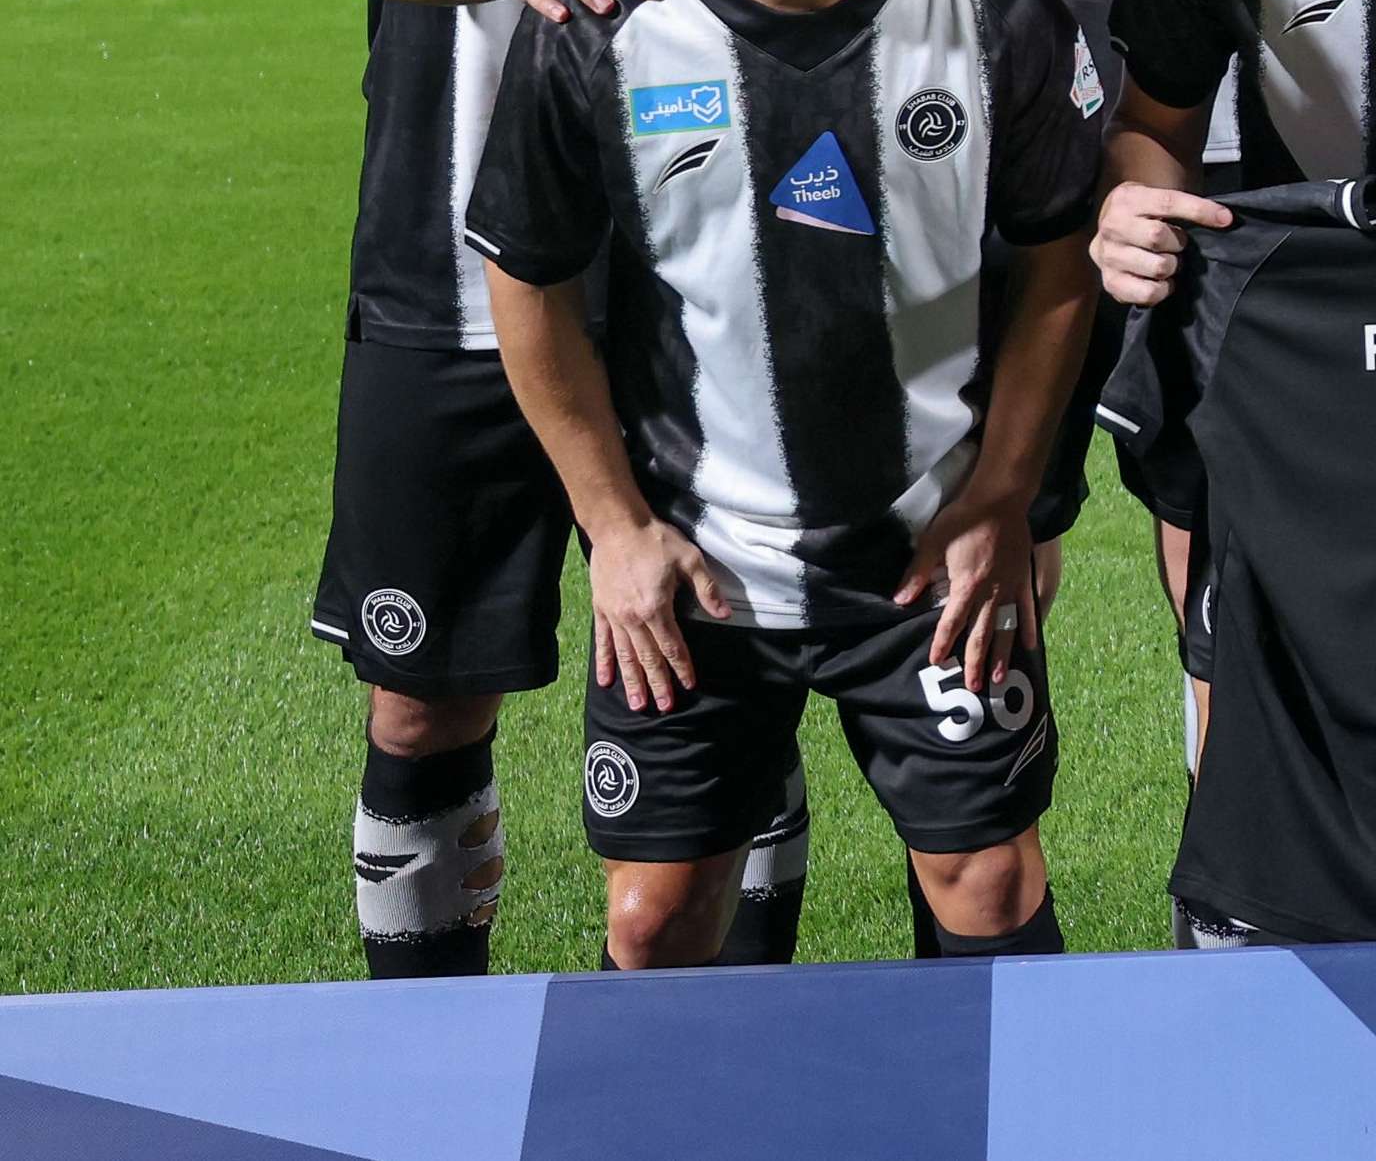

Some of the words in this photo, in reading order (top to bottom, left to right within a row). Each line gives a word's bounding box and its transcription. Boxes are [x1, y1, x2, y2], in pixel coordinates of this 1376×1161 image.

[906, 93, 936, 111] SHABAB
[937, 93, 956, 107] CLUB
[790, 165, 839, 187] ذيب
[792, 185, 841, 203] Theeb
[371, 594, 395, 606] SHABAB
[395, 596, 412, 610] CLUB
[918, 655, 1034, 742] 56
[610, 749, 627, 766] CLUB
